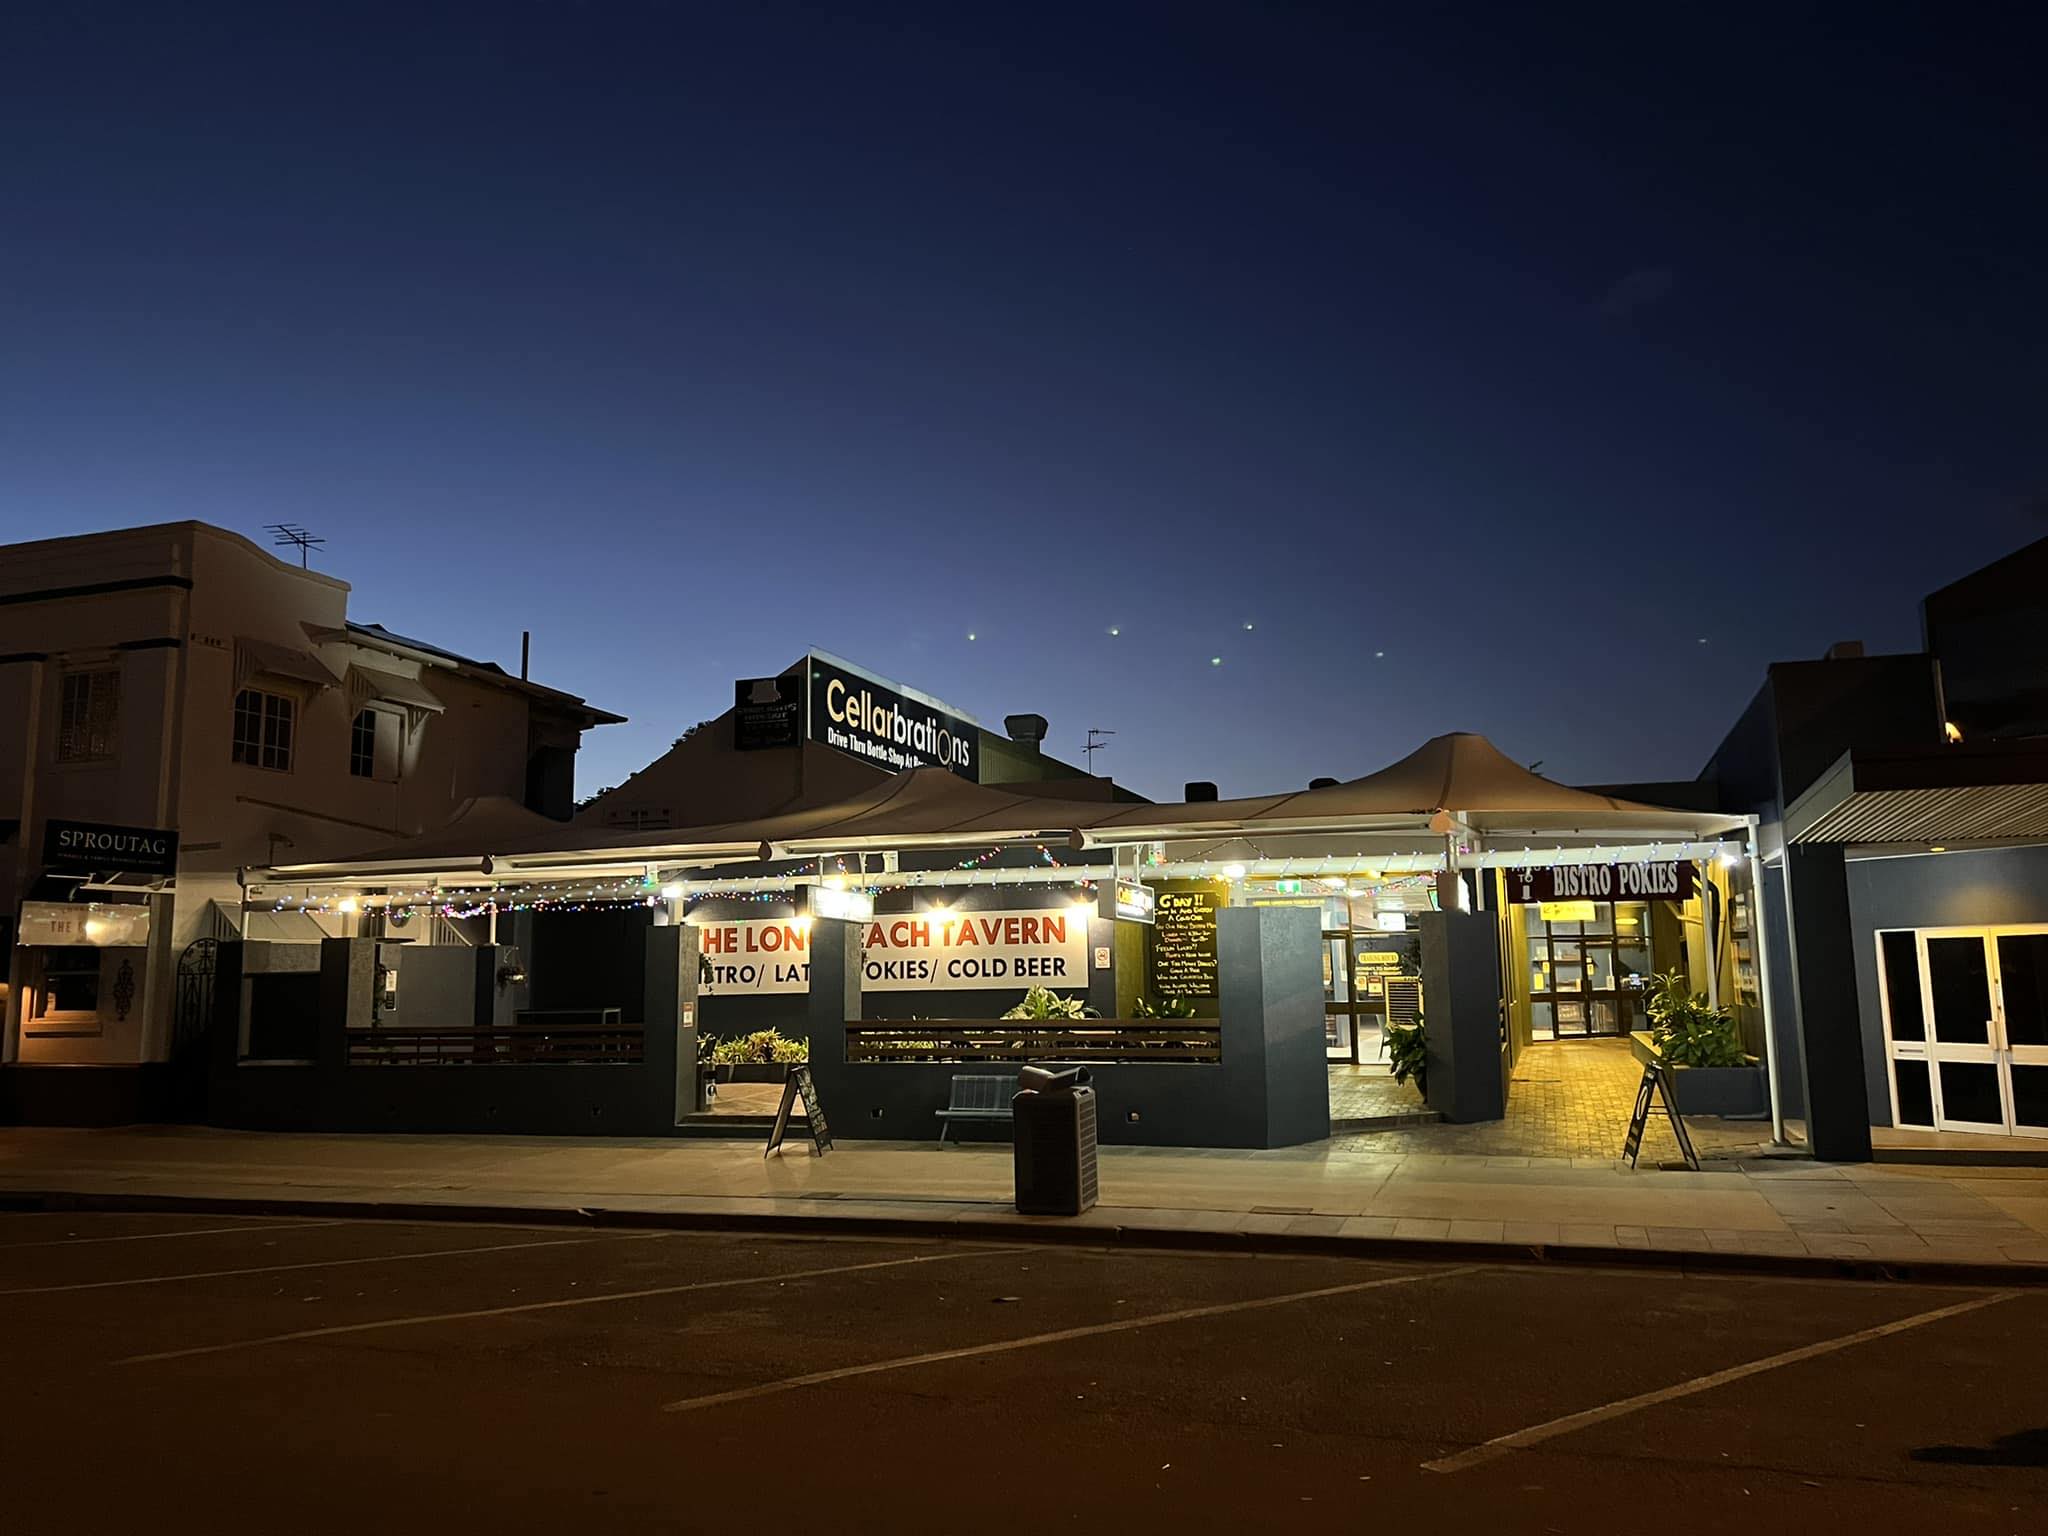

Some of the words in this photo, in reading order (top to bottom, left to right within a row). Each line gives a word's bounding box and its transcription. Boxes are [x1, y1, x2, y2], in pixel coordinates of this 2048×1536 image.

[827, 726, 848, 750] Drive
[849, 733, 866, 754] Thru
[866, 739, 887, 761] Bottle
[887, 746, 904, 770] Shop
[905, 753, 913, 768] At
[59, 830, 166, 855] SPROUTAG
[1553, 865, 1611, 897] BISTRO
[1618, 862, 1679, 895] POKIES
[699, 926, 738, 954] HE
[861, 920, 930, 949] ACH
[941, 916, 1067, 948] TAVERN
[698, 963, 765, 988] ITRO/
[864, 958, 938, 984] OKIES/
[947, 957, 1008, 978] COLD
[1013, 957, 1067, 978] BEER
